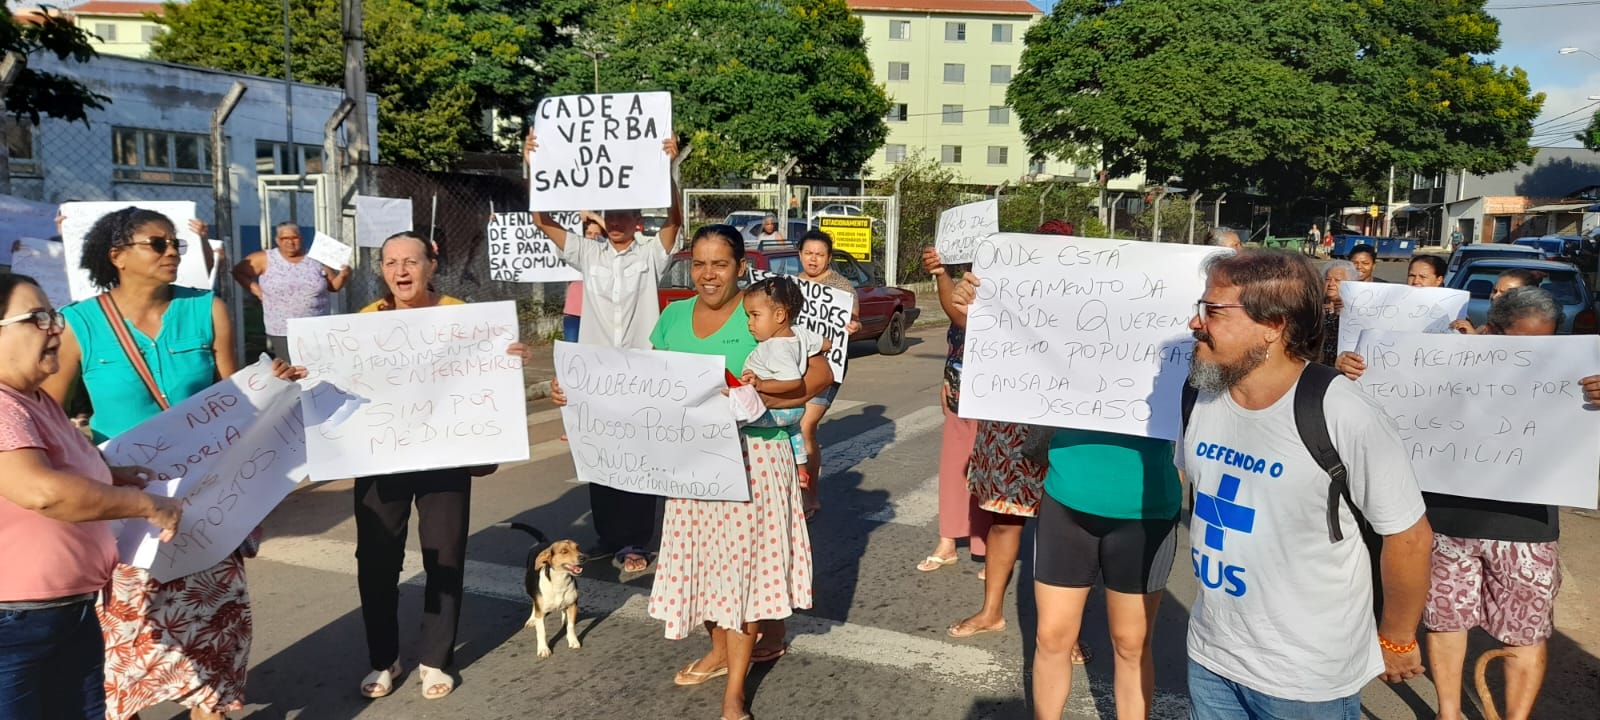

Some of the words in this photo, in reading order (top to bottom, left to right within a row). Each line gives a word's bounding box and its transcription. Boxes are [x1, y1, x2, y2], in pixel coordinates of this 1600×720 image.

[540, 94, 615, 120] CADE
[629, 94, 643, 116] A
[557, 116, 657, 143] VERBA
[580, 145, 611, 166] DA
[490, 227, 508, 241] DE
[491, 243, 510, 255] DE
[517, 241, 551, 255] PARA
[973, 239, 1044, 270] ONDE
[1058, 243, 1129, 269] ESTÁ
[490, 257, 508, 271] SA
[494, 270, 523, 281] ADE
[974, 277, 1124, 310] ORÇAMENTO
[1128, 272, 1168, 300] DA
[820, 303, 848, 328] DES
[969, 304, 1058, 332] SAÚDE
[297, 323, 360, 362] NÃO
[353, 340, 493, 370] ATENDIMENTO
[968, 337, 1049, 364] RESPEITO
[1414, 347, 1533, 368] ACEITAMOS
[971, 373, 1070, 398] CANSADA
[1096, 376, 1135, 393] DO
[1532, 380, 1574, 398] POR
[186, 391, 238, 429] NÃO
[365, 399, 433, 427] SIM
[449, 389, 499, 414] POR
[1030, 393, 1153, 422] DESCASO
[1494, 415, 1537, 436] DA
[1196, 442, 1266, 474] DEFENDA
[1269, 462, 1284, 478] O
[1191, 547, 1247, 597] SUS
